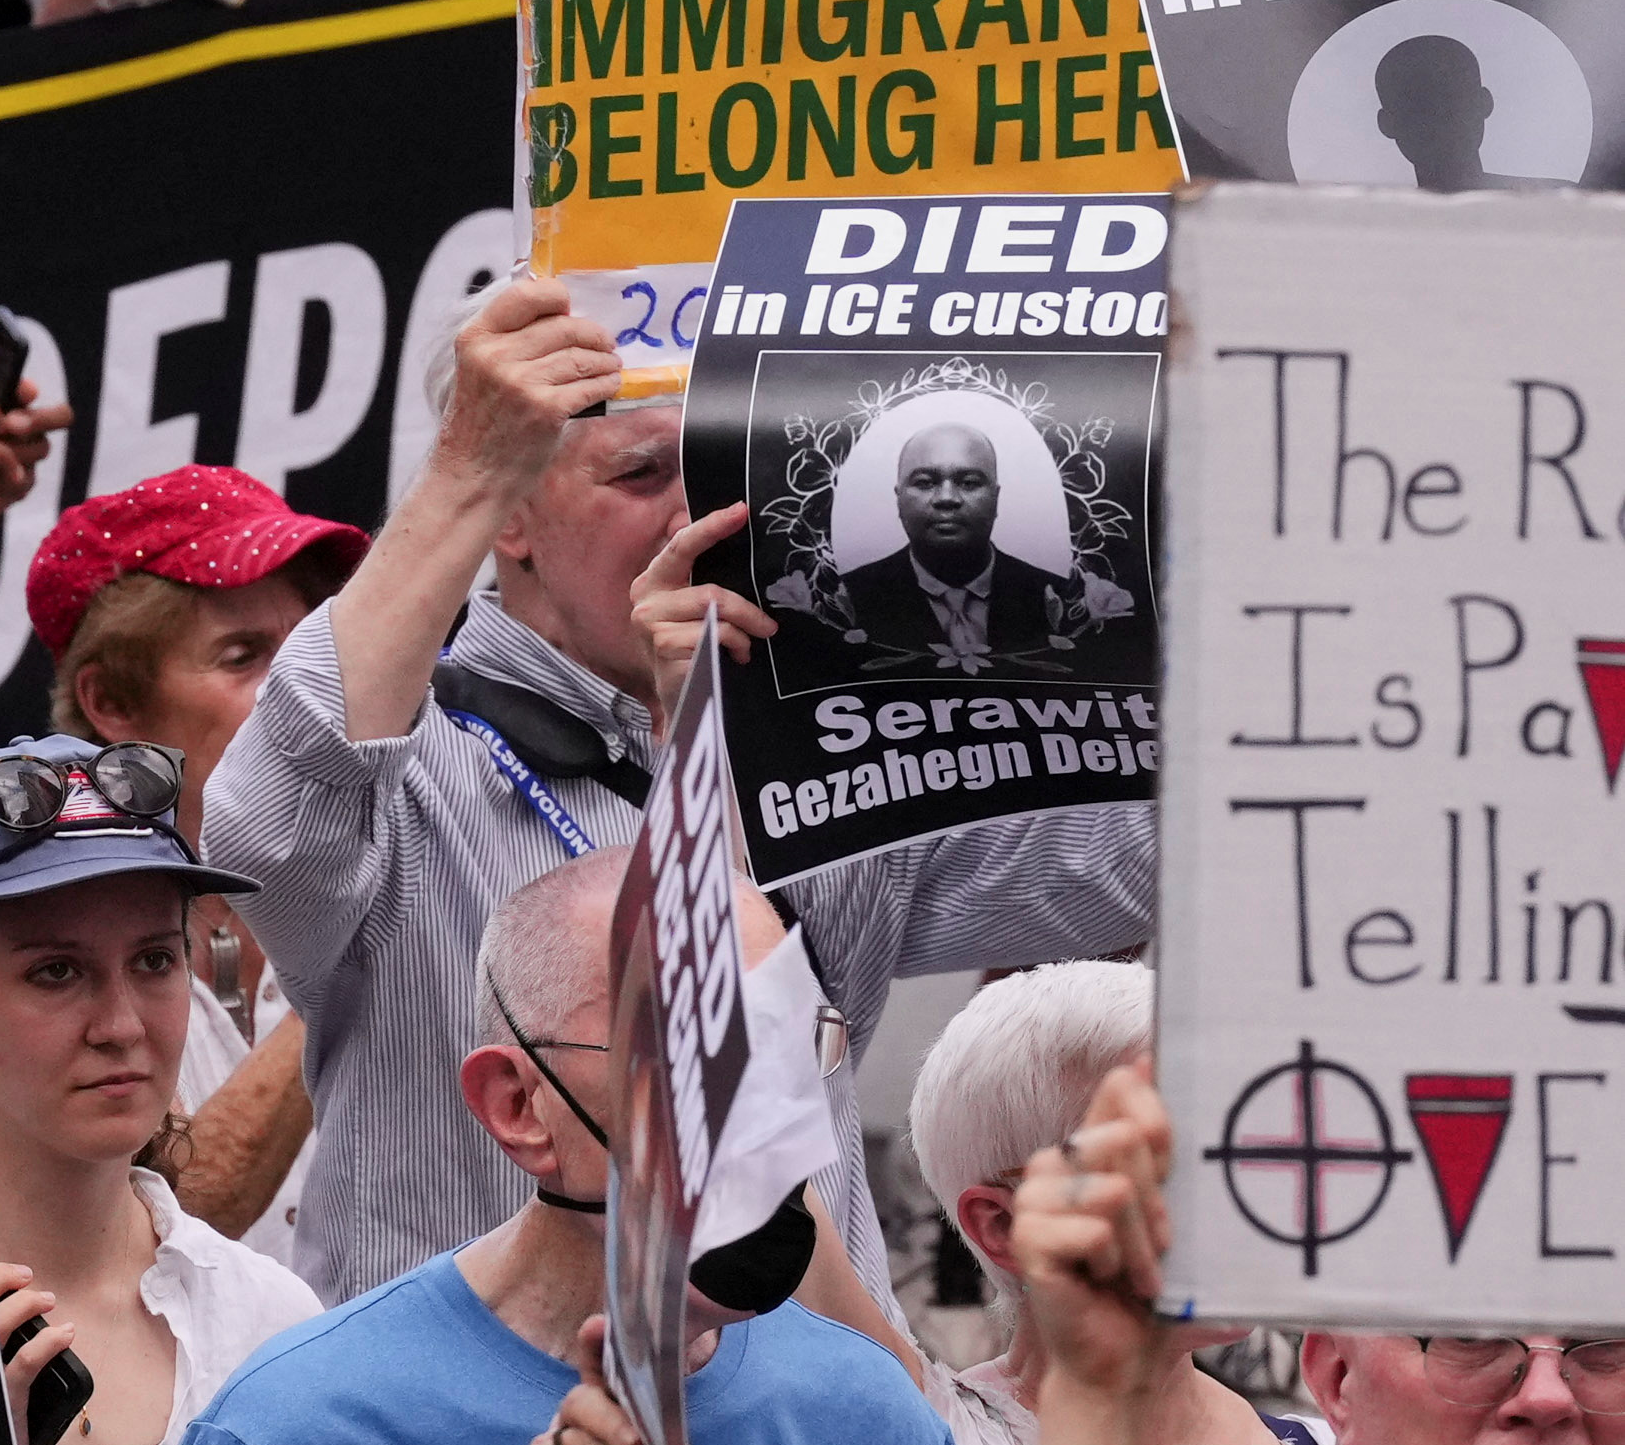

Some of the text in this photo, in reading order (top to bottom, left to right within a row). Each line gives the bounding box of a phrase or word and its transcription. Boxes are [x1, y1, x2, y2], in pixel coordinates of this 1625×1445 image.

[527, 48, 1178, 208] BELONG HER
[803, 204, 1169, 276] DIED
[711, 286, 787, 336] in
[799, 283, 921, 336] ICE
[1215, 348, 1469, 544] The
[813, 689, 1157, 755] Serawit
[1230, 603, 1426, 748] Is
[465, 719, 595, 856] WALSH VOLUN
[756, 733, 1034, 841] Gezahegn
[1227, 798, 1625, 992] Tellin
